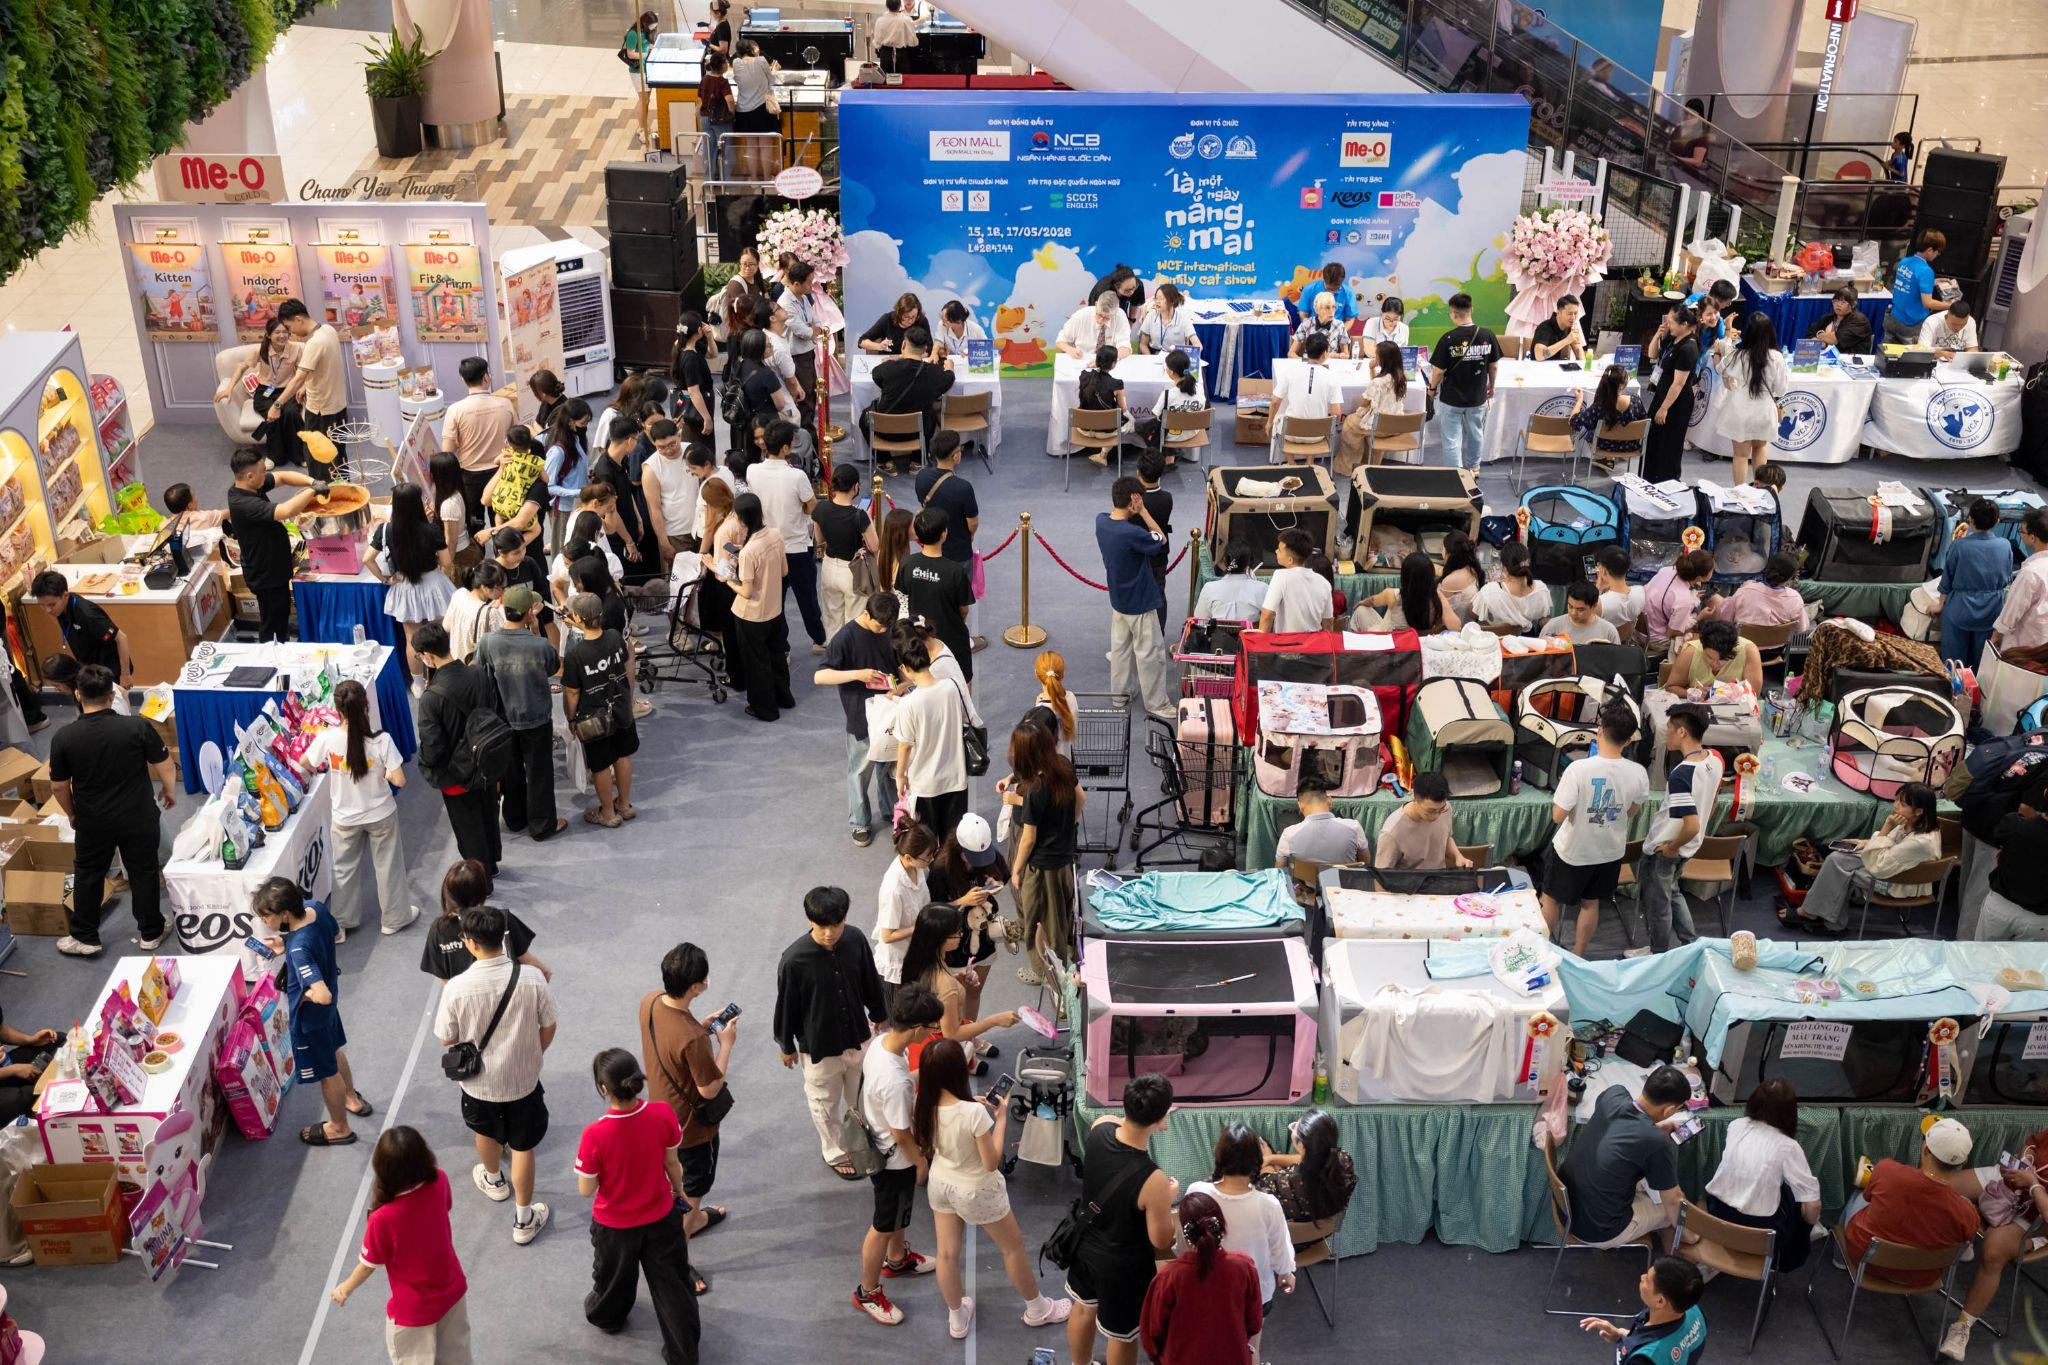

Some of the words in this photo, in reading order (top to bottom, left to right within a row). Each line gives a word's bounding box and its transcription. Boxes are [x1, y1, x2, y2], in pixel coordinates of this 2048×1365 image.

[1816, 23, 1842, 113] INFORMATION
[970, 137, 1001, 147] MALL
[1054, 133, 1100, 146] NCB
[1345, 141, 1386, 157] Me-O
[180, 156, 265, 191] Me-O
[353, 176, 391, 200] Yêu
[1172, 171, 1195, 194] Là
[1198, 174, 1223, 189] một
[1066, 193, 1098, 202] SCOTS
[1207, 187, 1240, 201] ngày
[968, 227, 985, 239] 15,
[1188, 219, 1255, 255] mai
[150, 250, 186, 264] Me-O
[240, 250, 276, 264] Me-O
[334, 251, 370, 264] Me-O
[424, 251, 459, 264] Me-O
[1157, 260, 1184, 271] WCF
[1184, 260, 1256, 272] international
[154, 272, 192, 283] Kitten
[243, 275, 281, 286] Indoor
[333, 273, 378, 283] Persian
[1199, 273, 1222, 285] cat
[1224, 274, 1257, 285] show
[267, 286, 290, 296] Cat
[445, 279, 472, 291] Firm
[1795, 424, 1810, 436] VCA
[175, 912, 254, 948] eos
